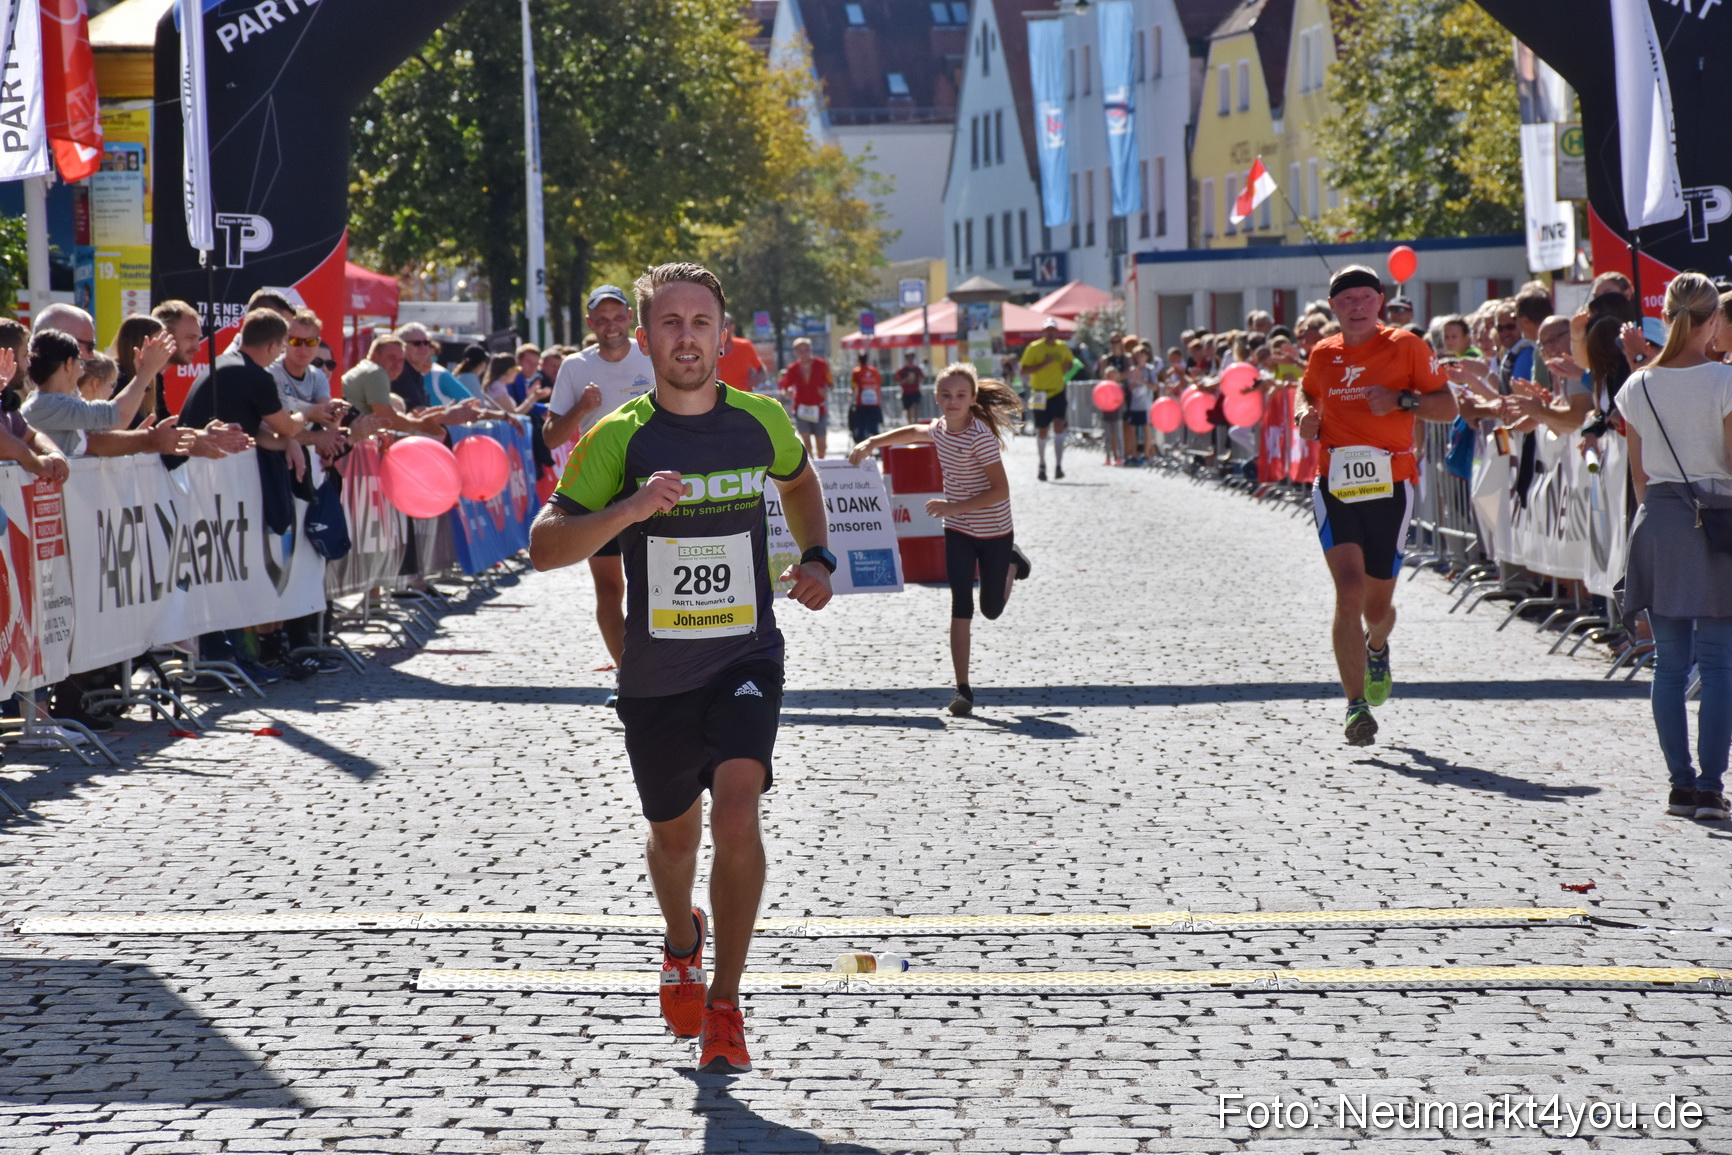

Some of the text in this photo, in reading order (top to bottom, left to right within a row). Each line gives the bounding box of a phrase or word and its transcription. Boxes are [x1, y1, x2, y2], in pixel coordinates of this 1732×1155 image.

[97, 262, 119, 279] 19.
[223, 303, 248, 315] NEX
[200, 317, 240, 328] YARS
[1342, 461, 1376, 480] 100
[639, 470, 766, 503] OCK
[840, 482, 853, 490] und
[1337, 486, 1386, 498] Hans-Werner
[683, 507, 696, 517] by
[699, 504, 731, 515] smart
[838, 496, 882, 514] DANK
[767, 521, 882, 536] ie onsoren
[678, 545, 726, 557] BOCK
[673, 564, 731, 595] 289
[672, 598, 726, 607] PARTL Neumarkt
[673, 612, 734, 627] Johannes
[734, 690, 763, 698] adidas
